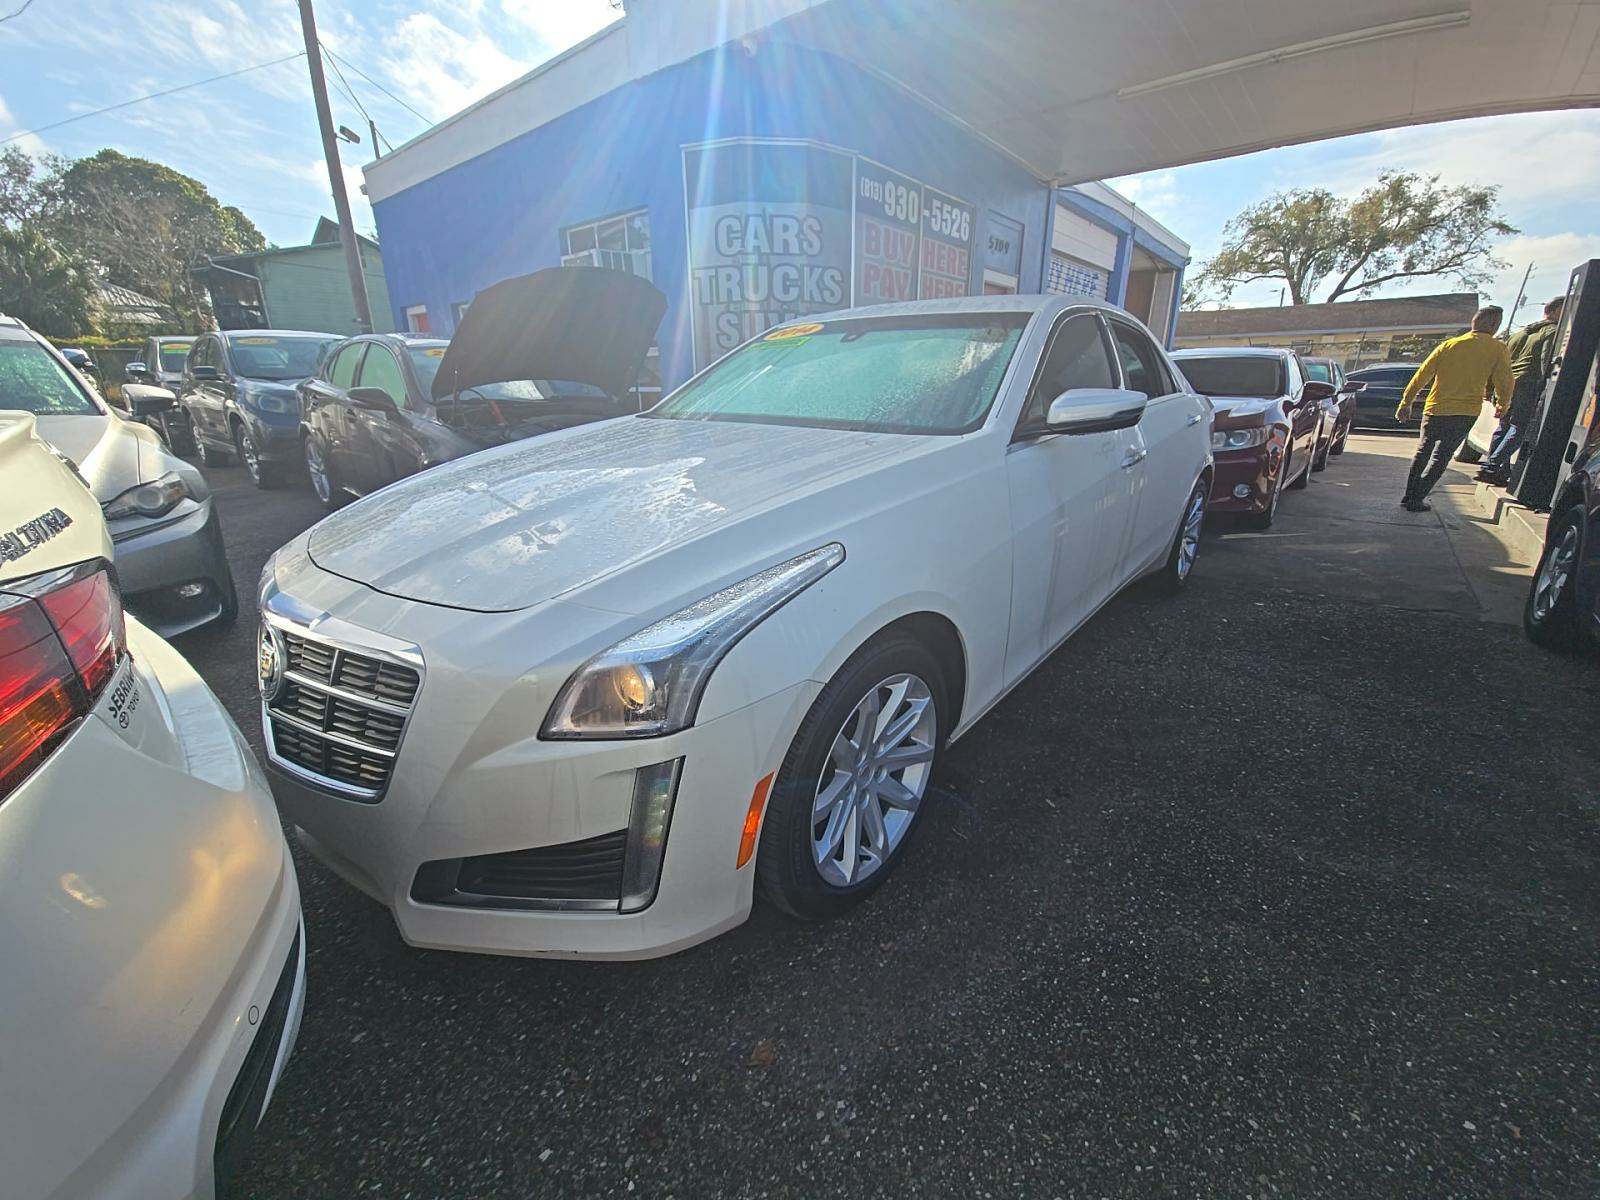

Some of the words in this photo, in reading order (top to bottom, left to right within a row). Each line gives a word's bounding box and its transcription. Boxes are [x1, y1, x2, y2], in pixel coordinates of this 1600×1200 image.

[715, 214, 822, 256] CARS
[884, 180, 970, 242] 930-5526
[863, 218, 916, 268] BUY
[921, 236, 969, 278] HERE
[693, 264, 845, 304] TRUCKS
[863, 260, 913, 301] PAY
[0, 507, 73, 568] ALTIMA
